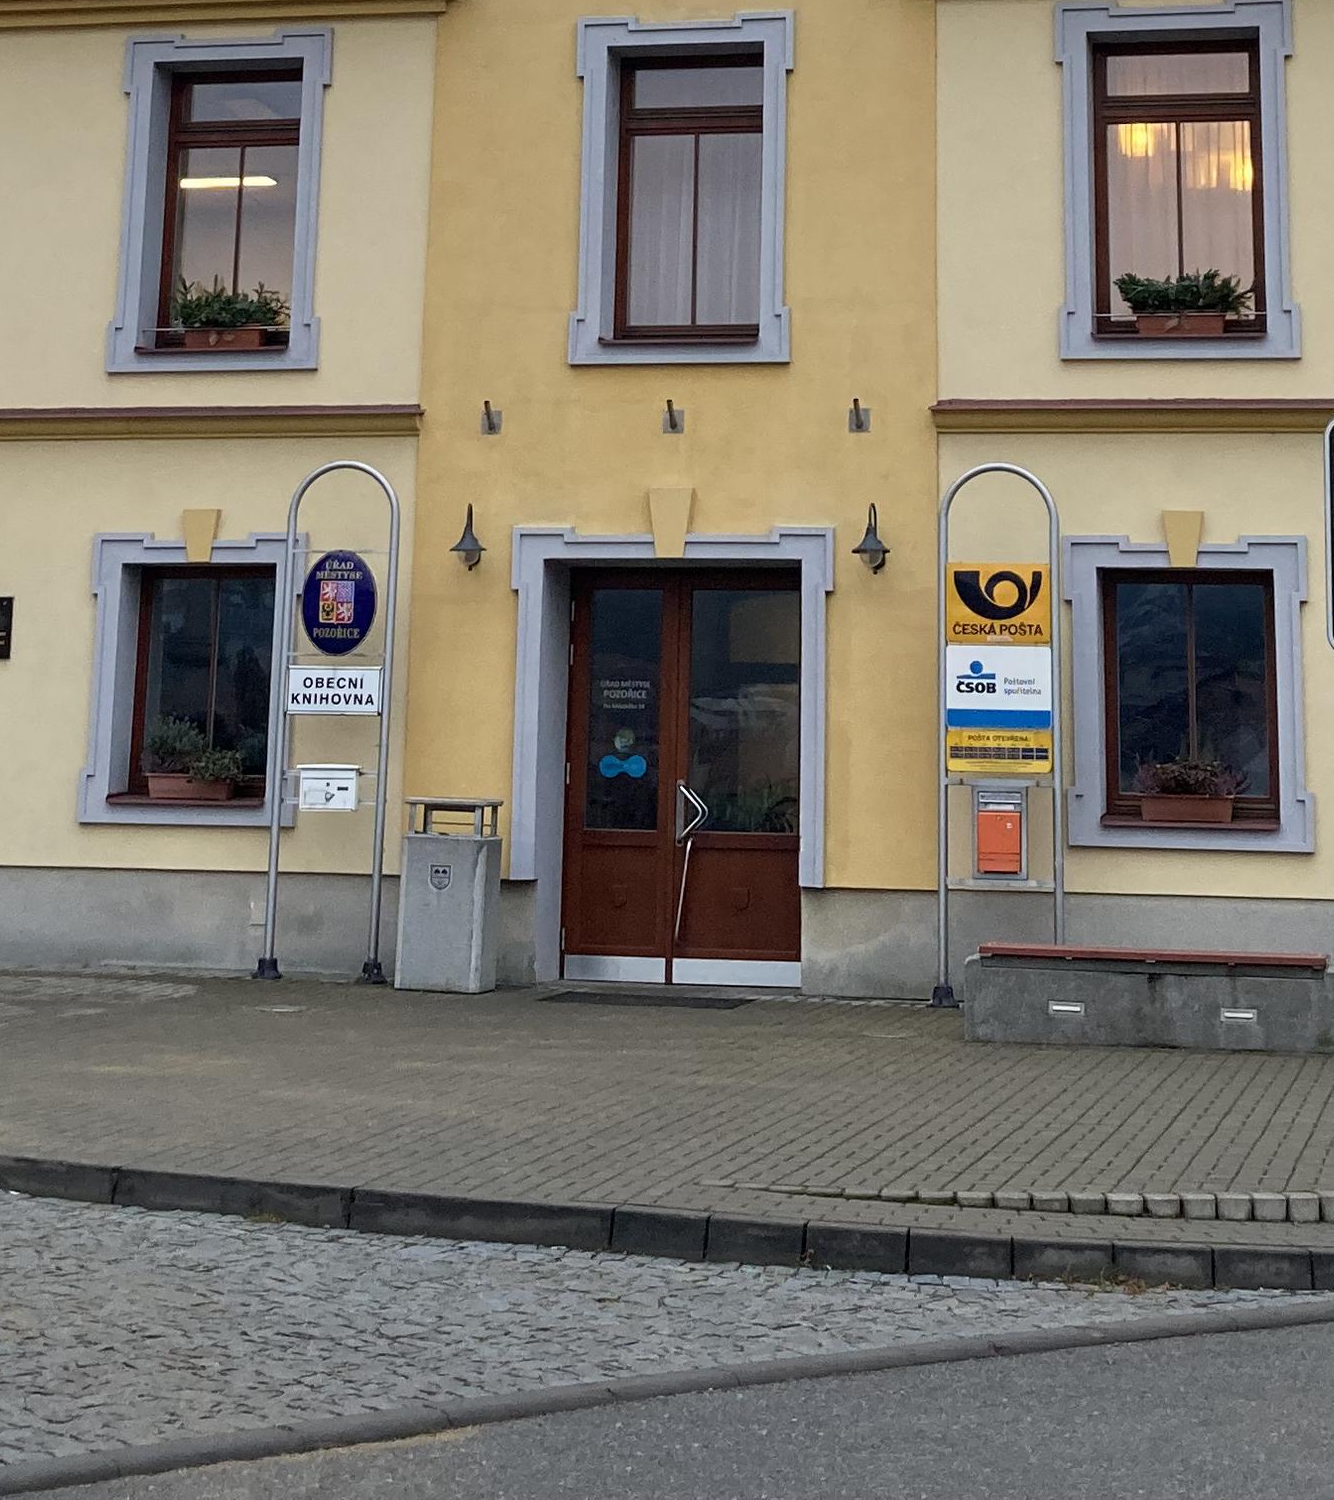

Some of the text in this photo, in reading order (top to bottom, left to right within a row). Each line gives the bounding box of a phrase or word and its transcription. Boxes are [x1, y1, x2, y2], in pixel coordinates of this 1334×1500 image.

[325, 560, 354, 570] ÚŘAD
[312, 626, 361, 639] POZOŘICE
[952, 621, 1044, 636] ČESKÁ POŠTA
[303, 674, 365, 689] OBECNÍ
[956, 680, 997, 694] ČSOB
[291, 693, 374, 706] KNIHOVNA
[603, 689, 647, 699] POZOŘICE
